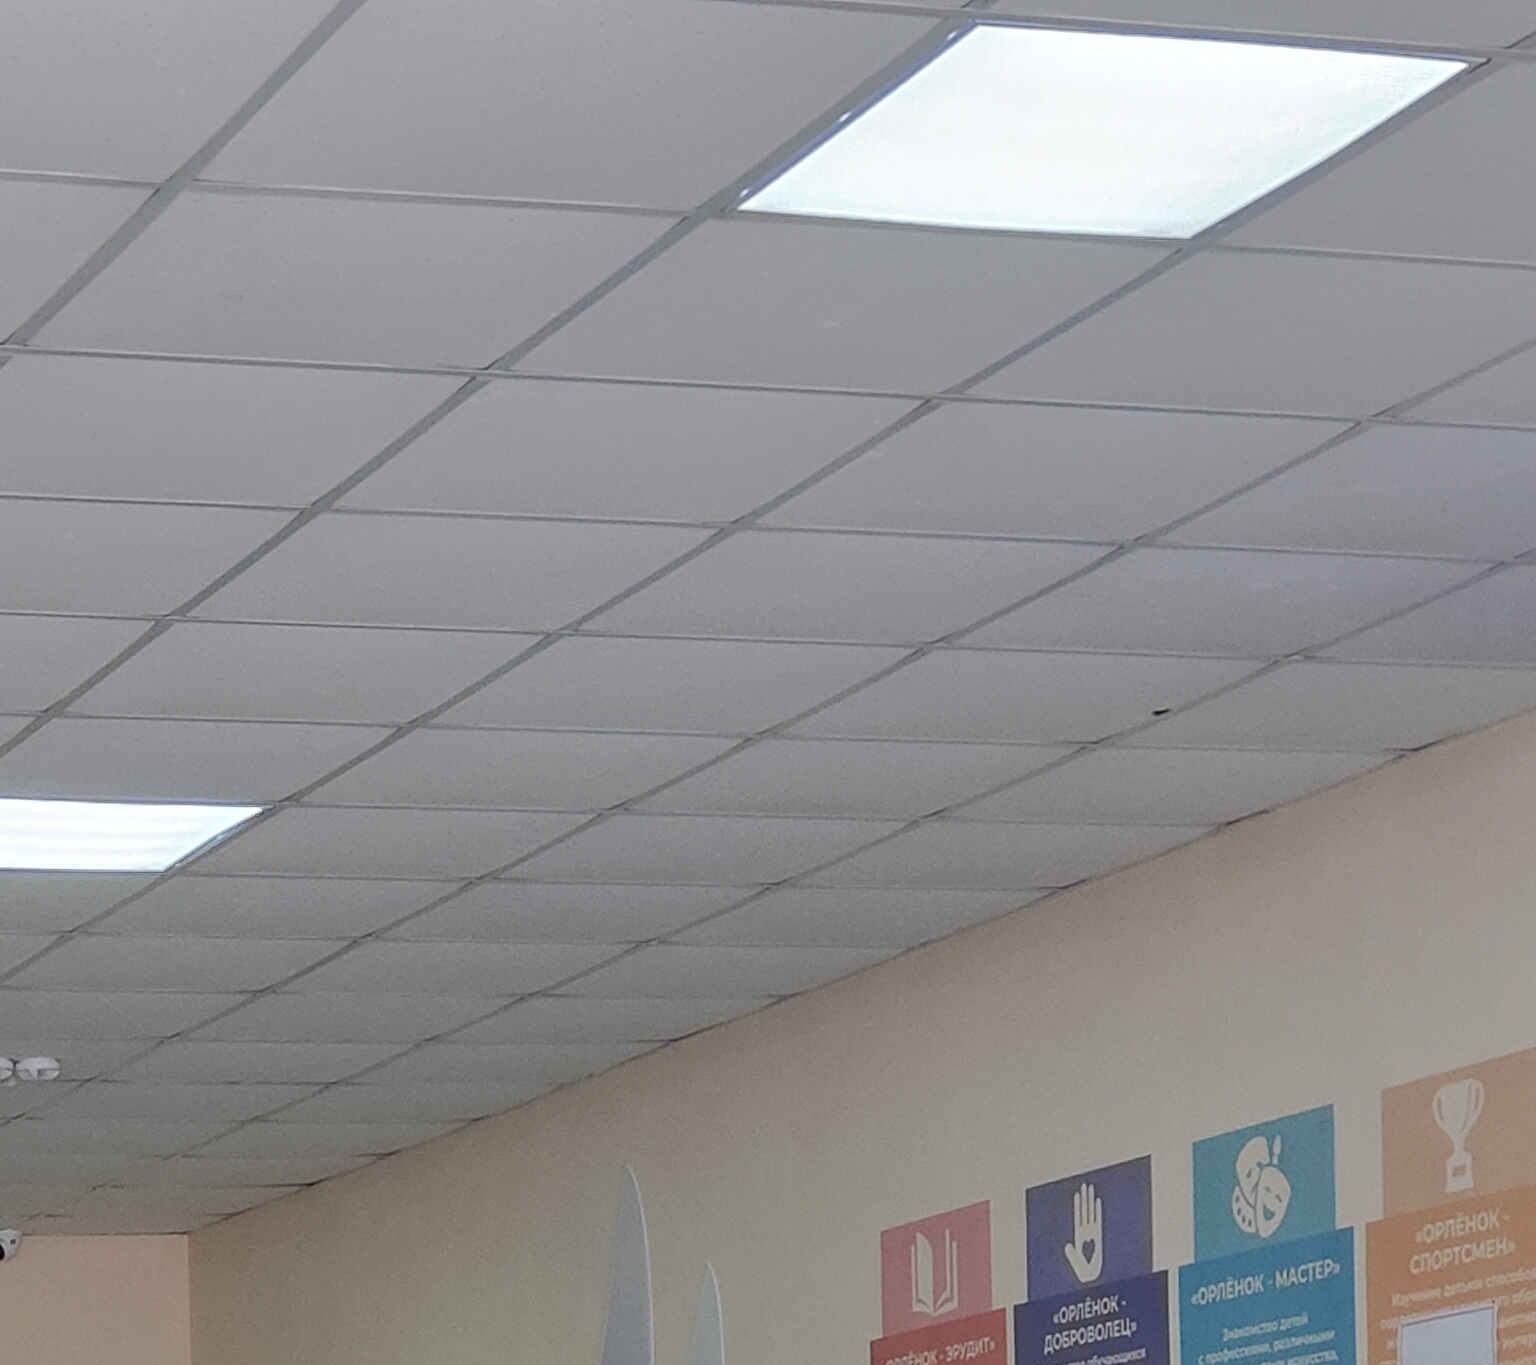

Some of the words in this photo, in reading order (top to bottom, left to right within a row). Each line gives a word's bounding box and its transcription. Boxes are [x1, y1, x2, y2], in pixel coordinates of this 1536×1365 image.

[1415, 1208, 1500, 1244] «ОРЛЁНОК
[1409, 1236, 1517, 1275] СПОРТСМЕН»
[1190, 1274, 1265, 1306] «ОРЛЁНОК
[1274, 1258, 1341, 1289] МАСТЕР»
[1052, 1294, 1120, 1325] «ОРЛЁНОК
[945, 1336, 997, 1363] ЭРУДИТ»
[1043, 1317, 1138, 1357] ДОБРОВОЛЕЦ»
